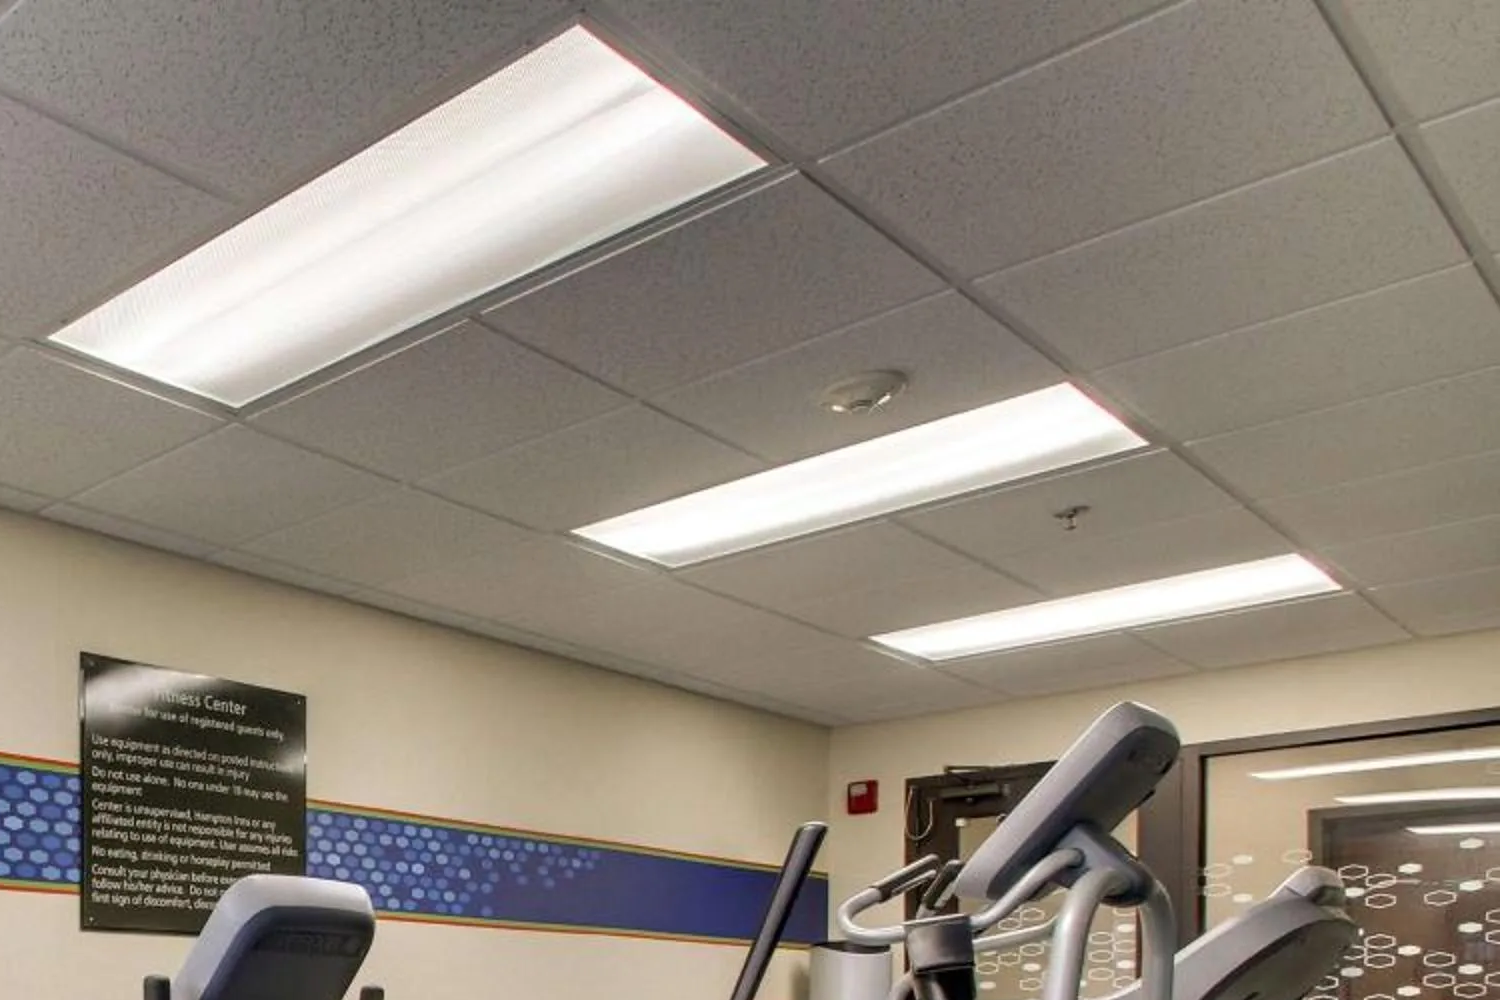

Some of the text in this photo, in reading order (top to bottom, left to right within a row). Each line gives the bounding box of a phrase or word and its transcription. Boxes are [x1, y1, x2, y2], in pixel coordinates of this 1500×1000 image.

[204, 695, 248, 716] Center
[92, 765, 107, 778] Do
[92, 798, 123, 813] Center
